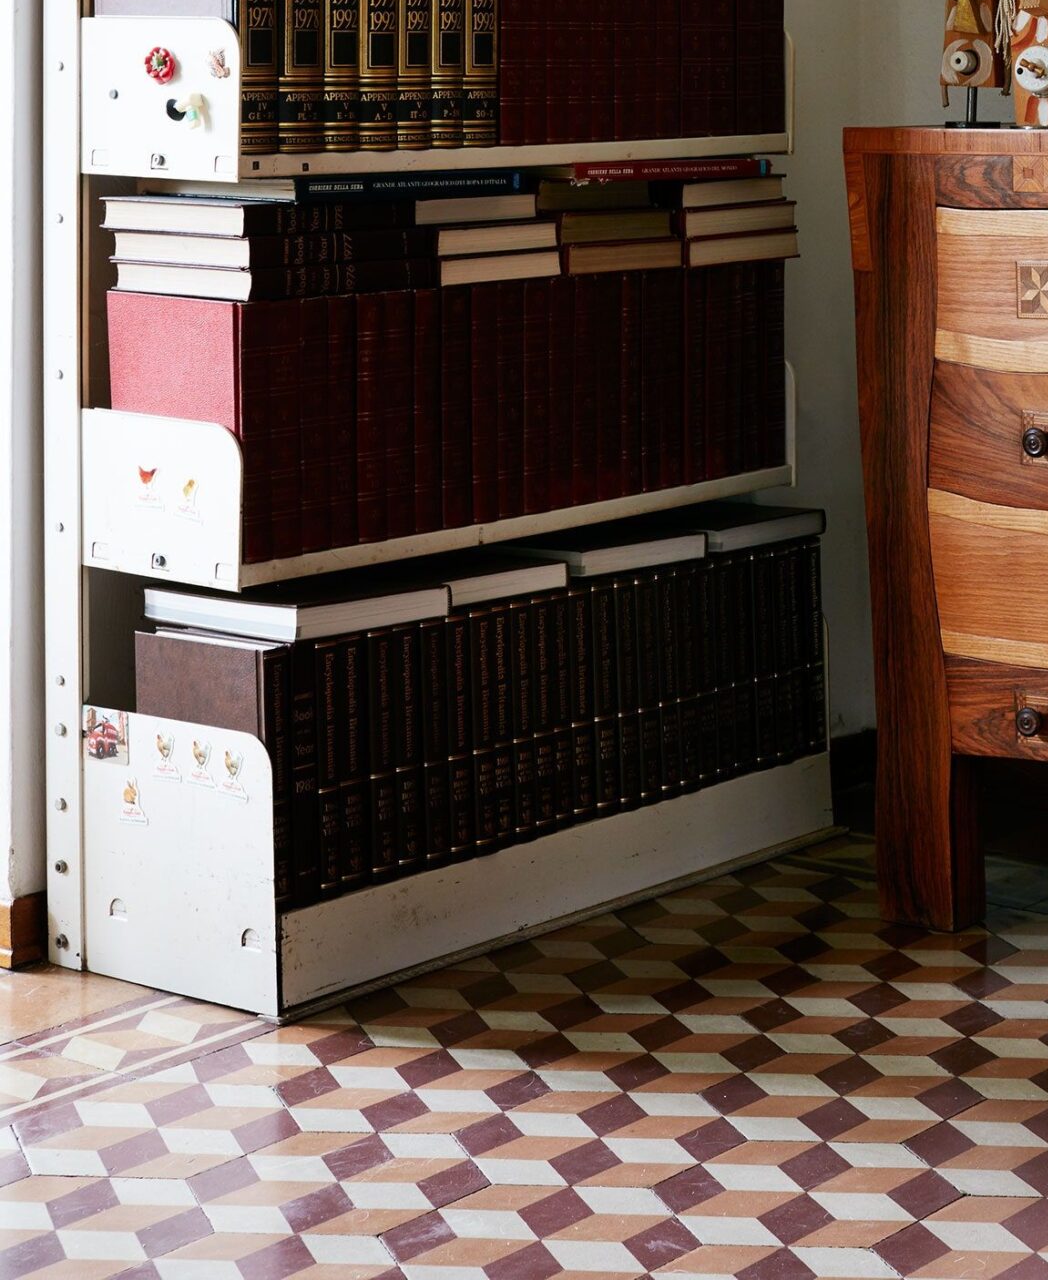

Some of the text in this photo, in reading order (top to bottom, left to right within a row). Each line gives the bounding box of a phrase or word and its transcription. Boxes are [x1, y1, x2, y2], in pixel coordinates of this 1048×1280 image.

[248, 7, 274, 28] 1978
[294, 8, 320, 29] 1978
[332, 9, 358, 30] 1992
[370, 11, 396, 31] 1992
[407, 10, 430, 30] 1992
[440, 10, 463, 30] 1992
[473, 11, 495, 31] 1992
